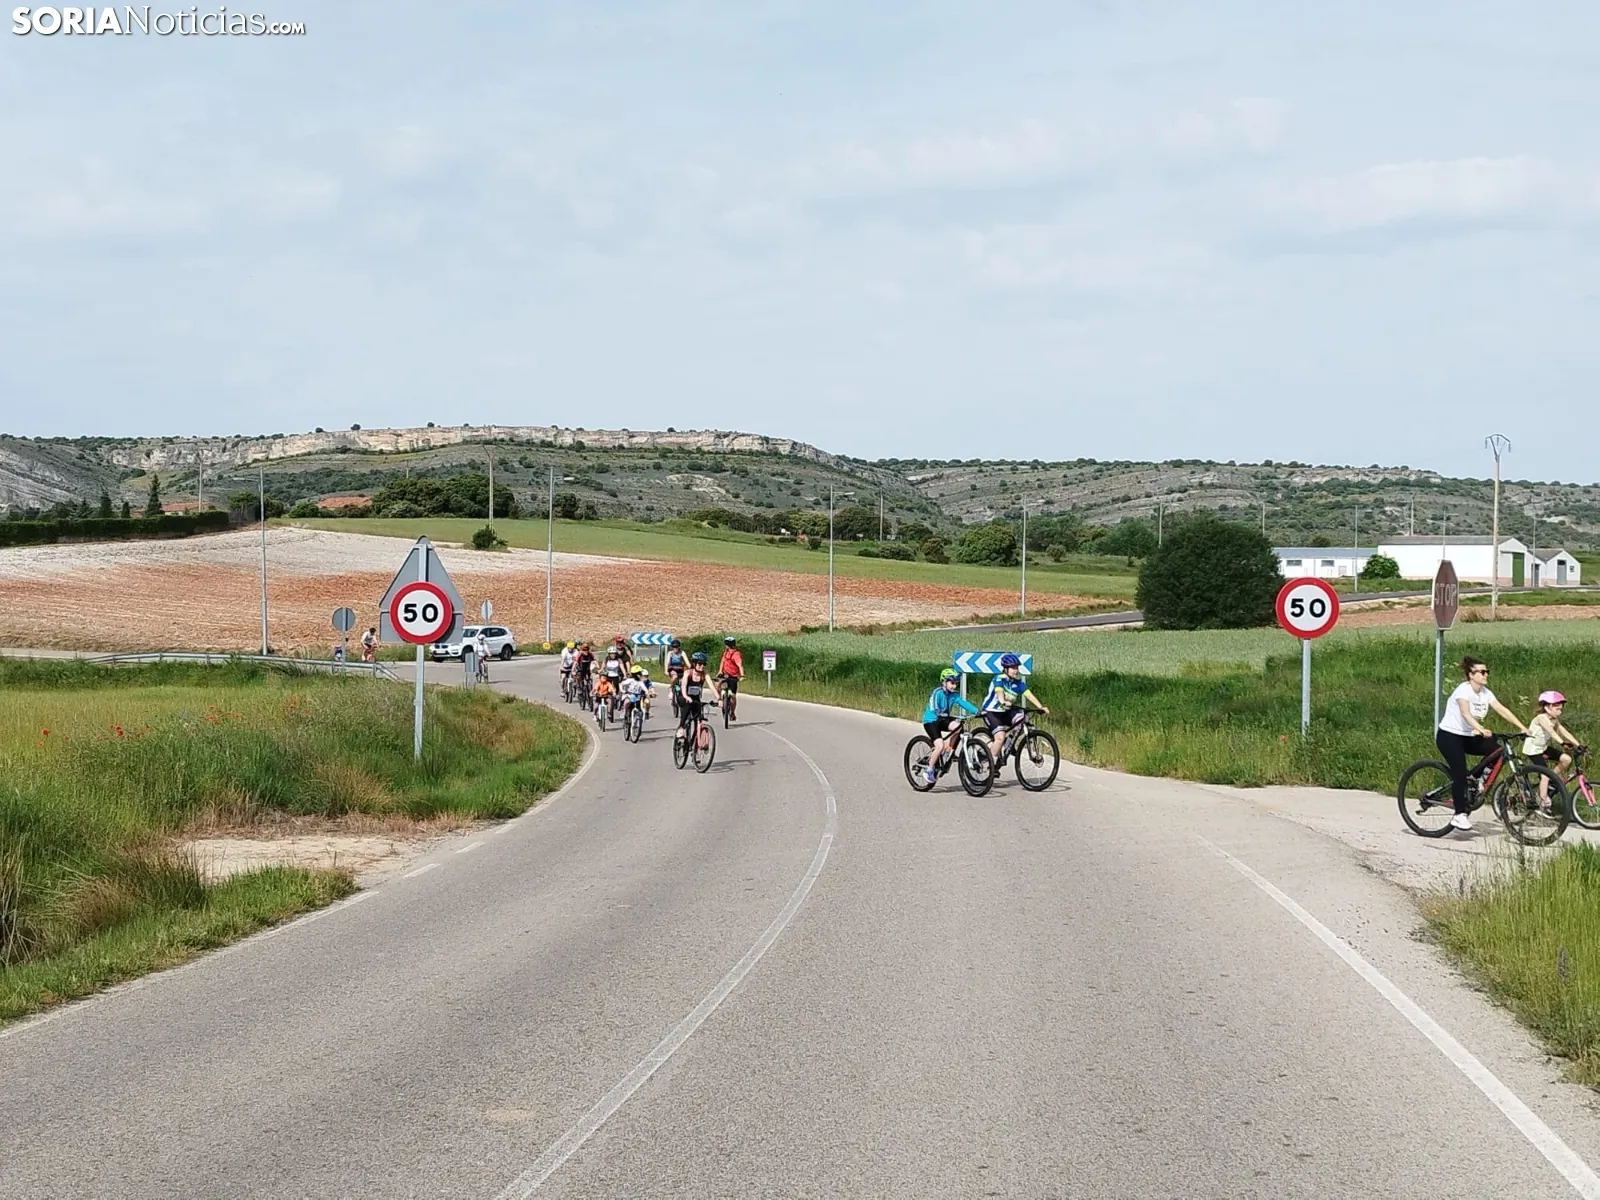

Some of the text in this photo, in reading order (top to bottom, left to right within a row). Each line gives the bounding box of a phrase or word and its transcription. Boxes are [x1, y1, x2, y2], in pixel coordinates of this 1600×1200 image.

[1435, 582, 1457, 607] STOP
[403, 603, 438, 622] 50
[1290, 598, 1326, 618] 50
